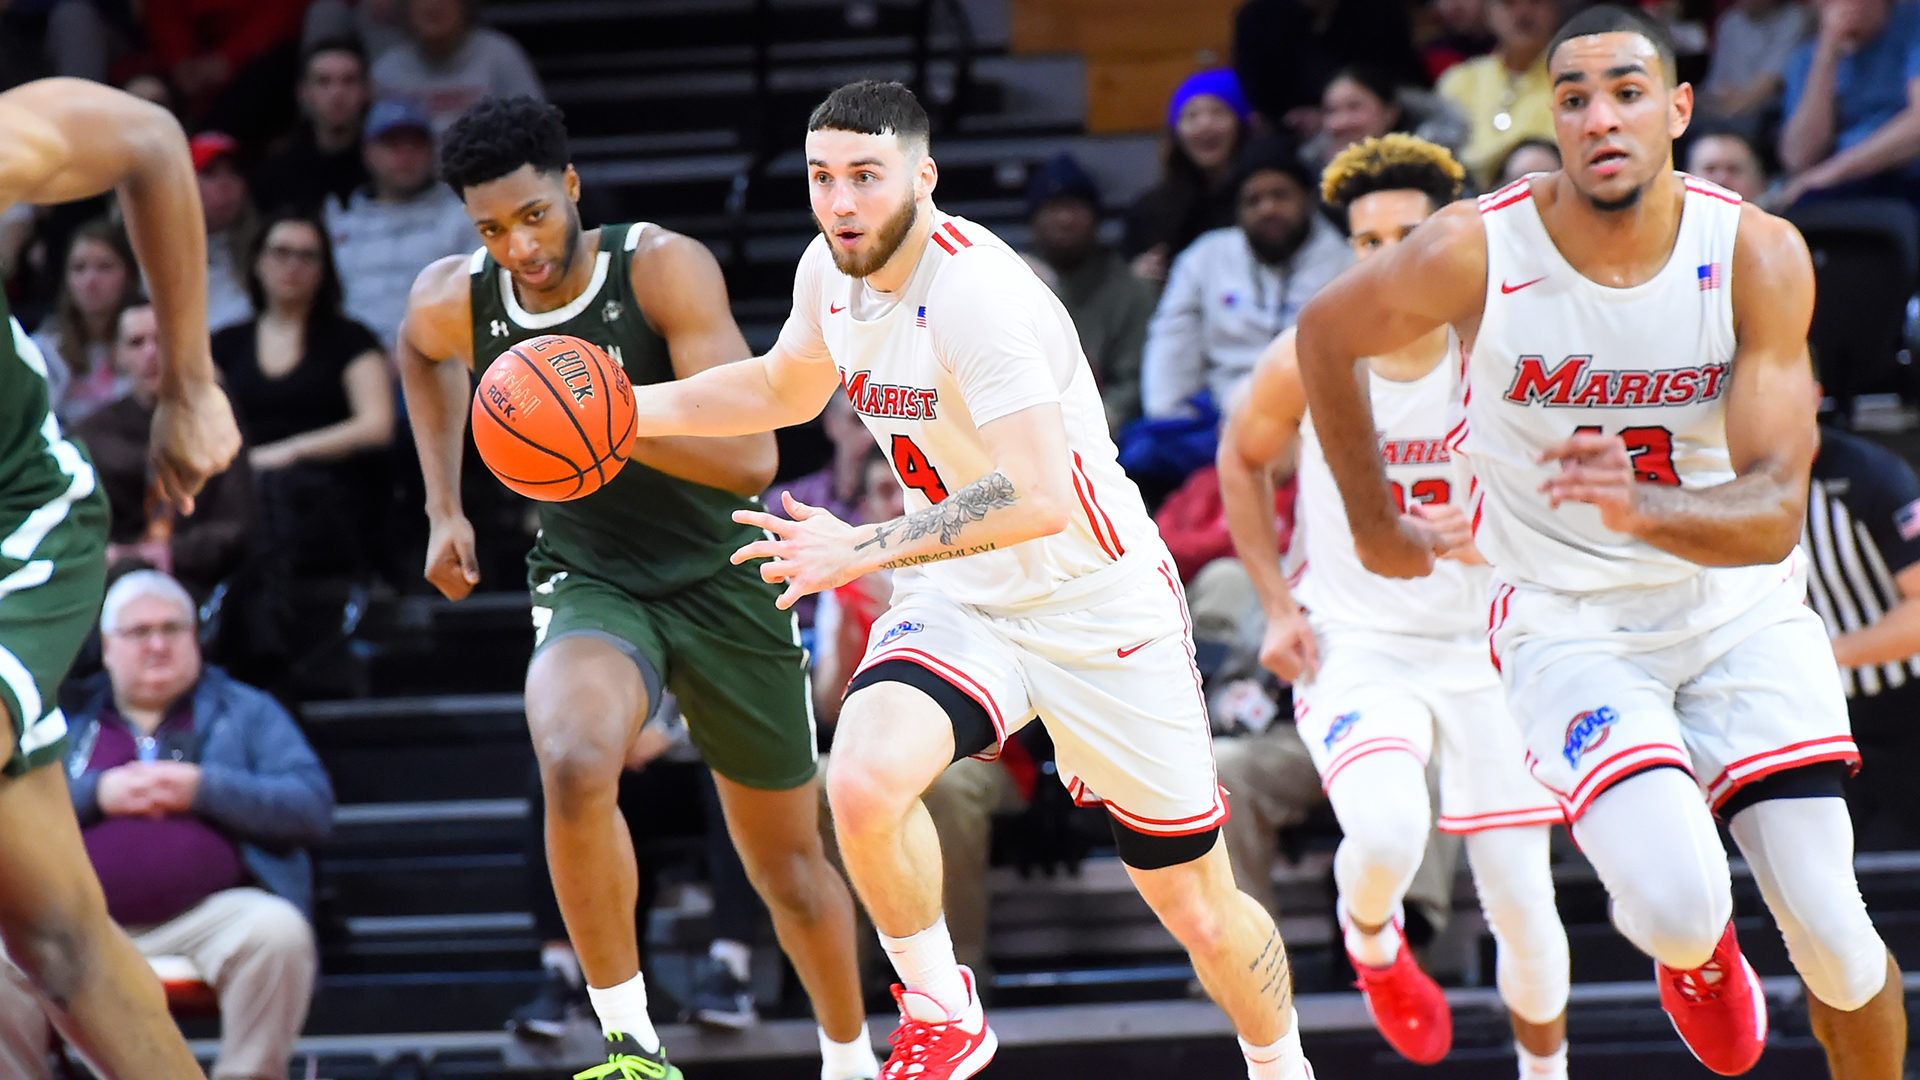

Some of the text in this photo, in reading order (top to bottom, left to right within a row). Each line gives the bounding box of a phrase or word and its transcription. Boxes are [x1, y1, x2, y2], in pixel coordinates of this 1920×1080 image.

[487, 384, 517, 420] ROCK
[547, 350, 595, 404] ROCK
[839, 366, 938, 420] MARIST
[1503, 354, 1730, 408] MARIST
[891, 434, 949, 504] 4
[1377, 431, 1451, 465] ARIS
[1574, 425, 1682, 487] 3
